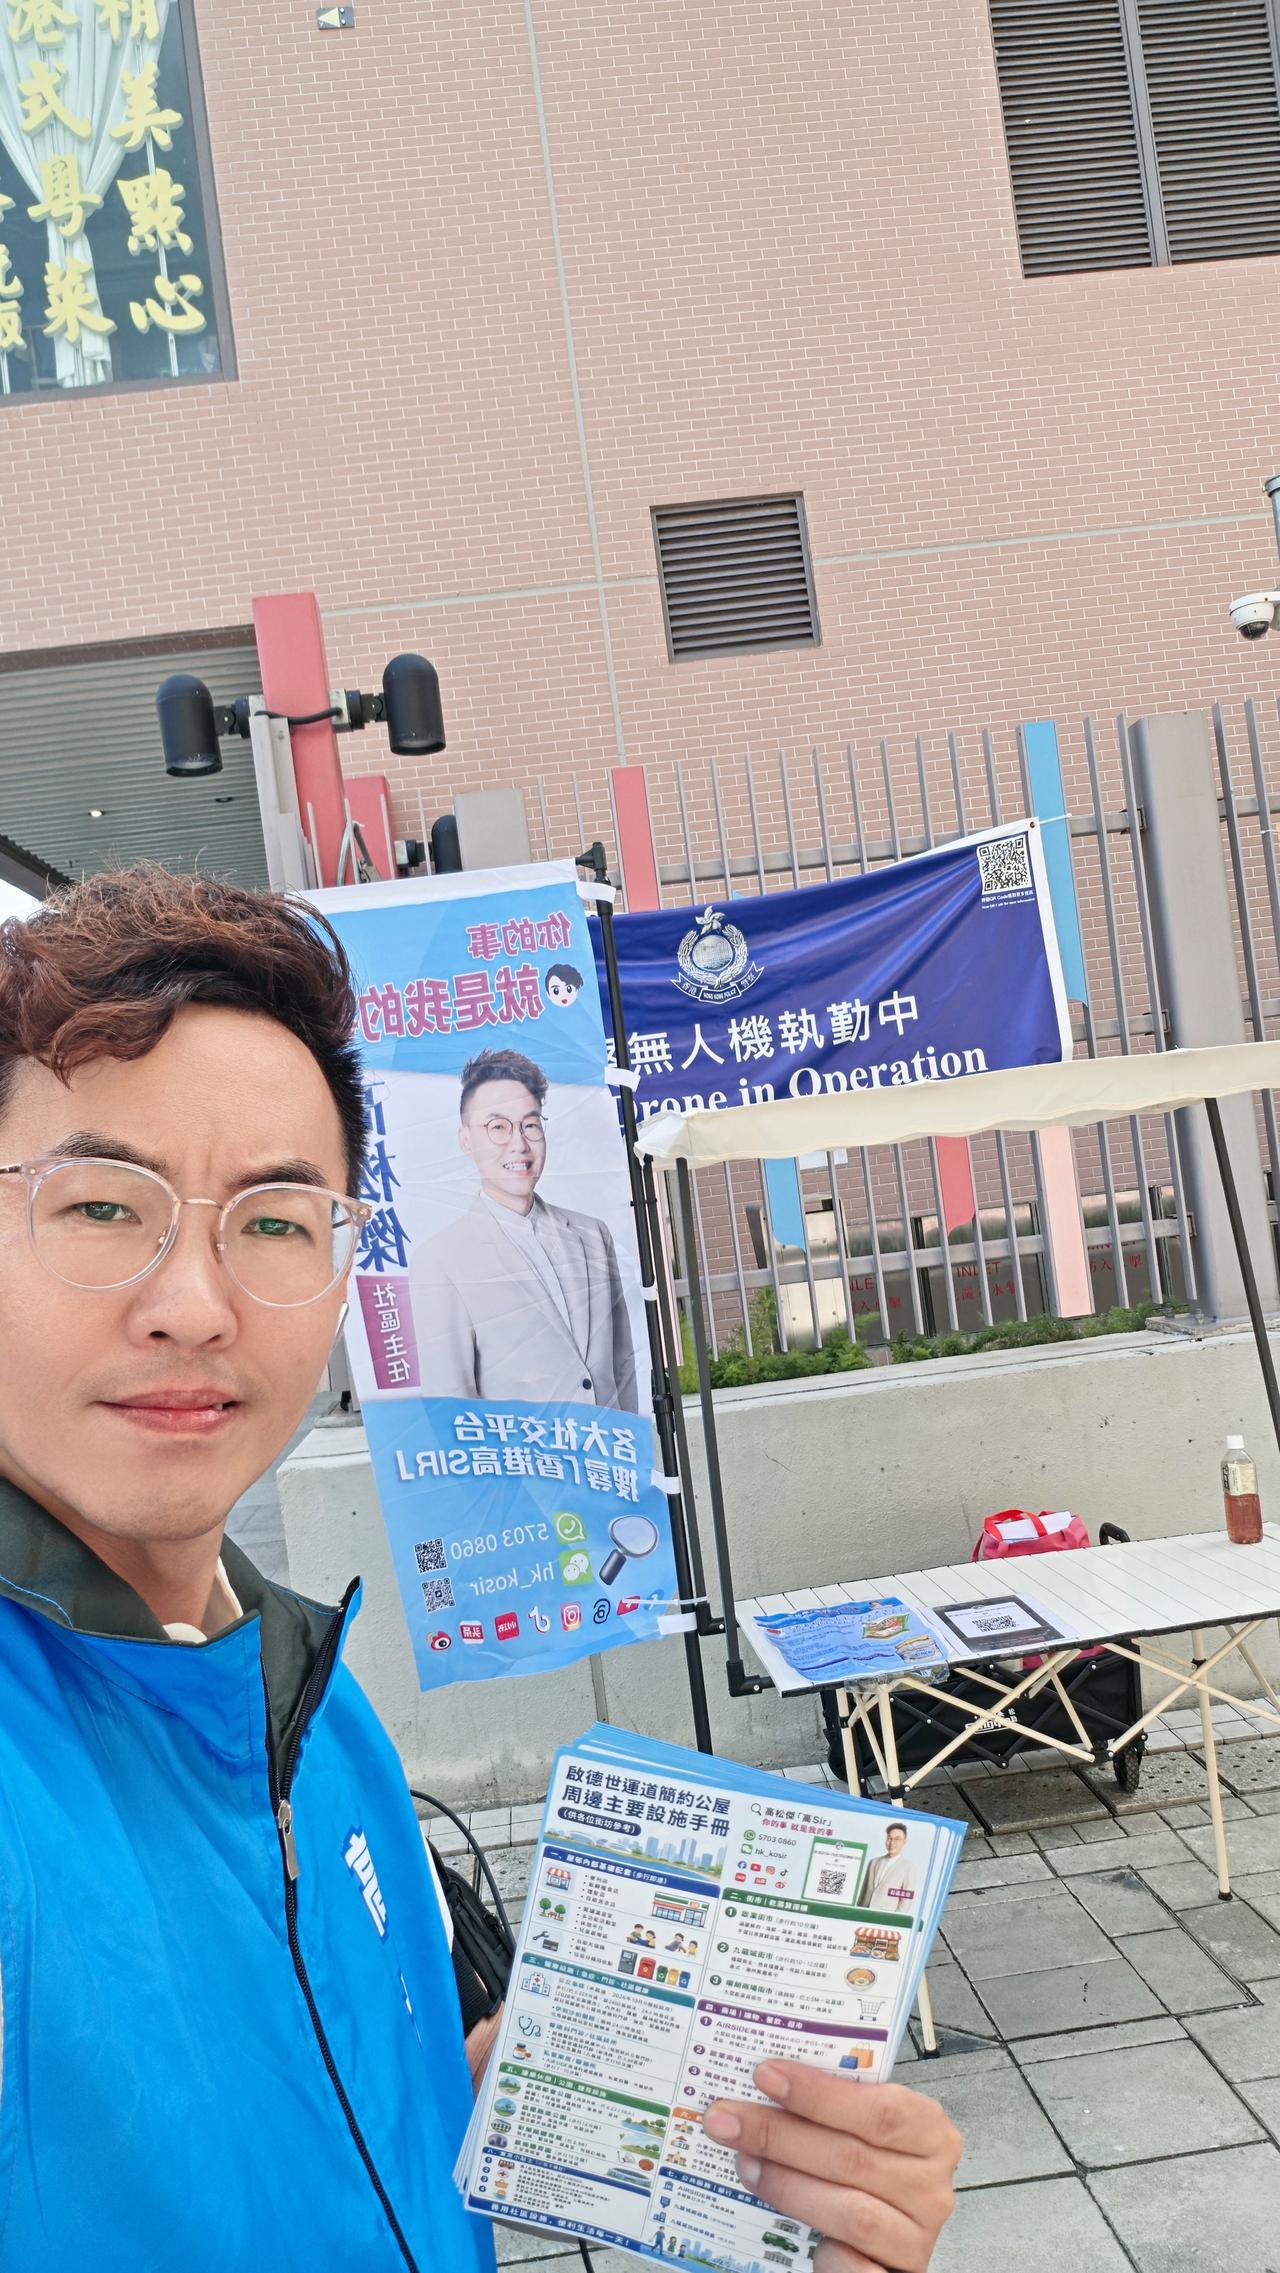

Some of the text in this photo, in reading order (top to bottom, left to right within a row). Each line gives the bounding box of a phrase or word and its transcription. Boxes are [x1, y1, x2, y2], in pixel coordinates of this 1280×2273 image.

[724, 989, 736, 998] POLICE
[605, 991, 918, 1075] 無人機執勤中
[738, 1078, 775, 1106] in
[789, 1045, 988, 1096] Operation
[565, 1765, 731, 1815] 啟德世運道簡約公屋
[561, 1785, 730, 1837] 周邊主要設施手冊
[762, 1818, 834, 1837] 你的事 就是我的事
[755, 1848, 788, 1860] hk_kosir
[758, 1834, 797, 1846] 5703 0860
